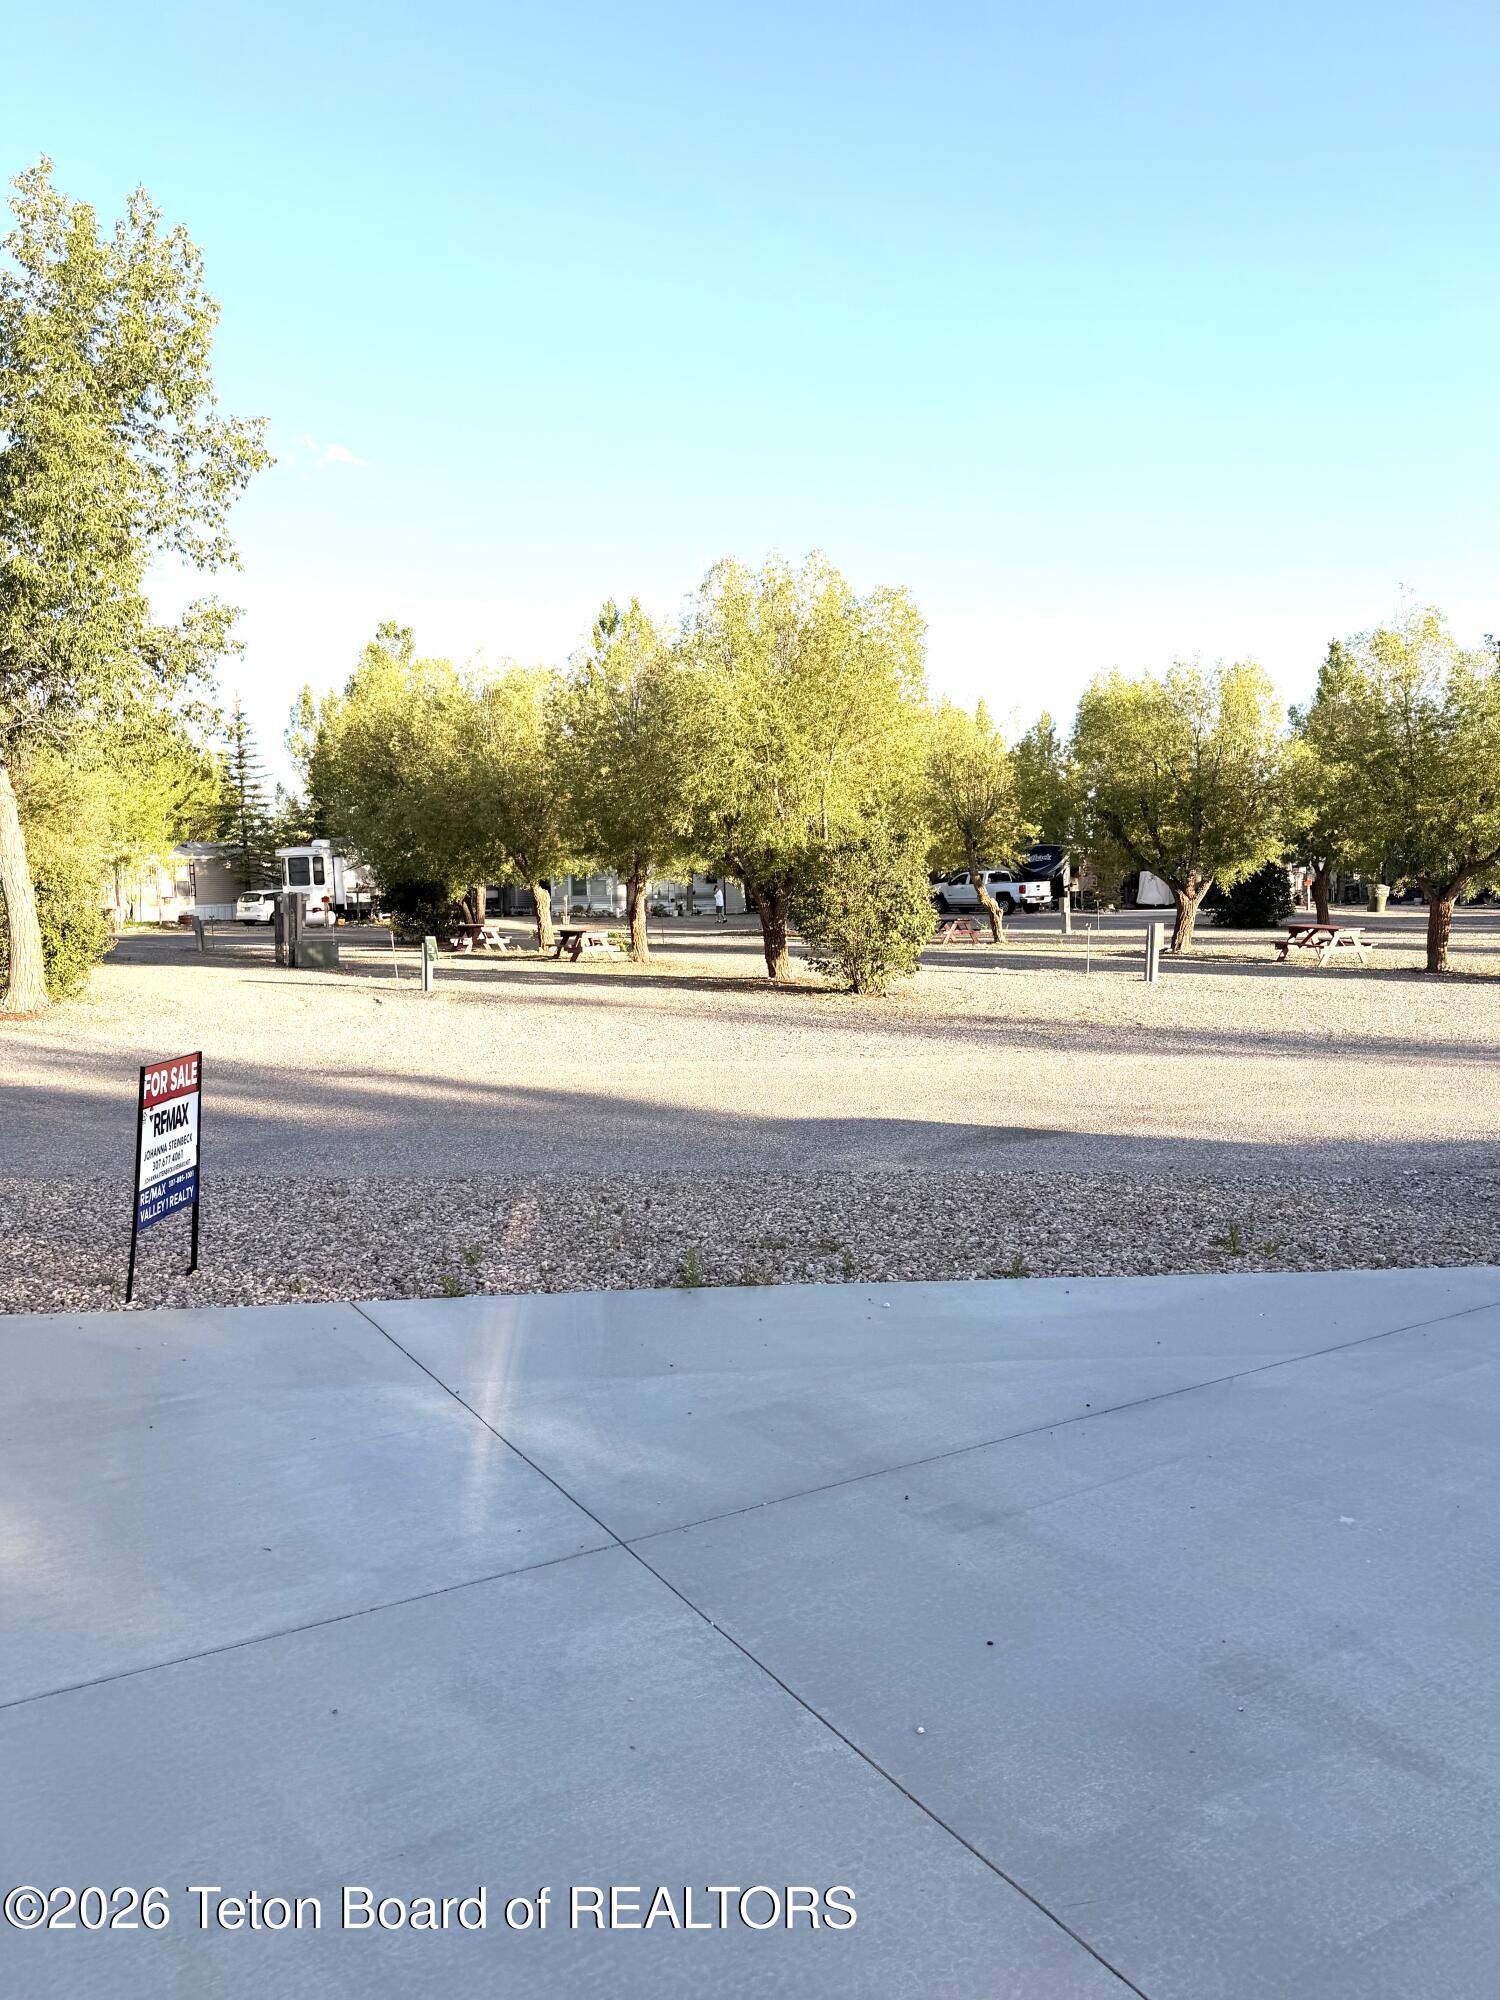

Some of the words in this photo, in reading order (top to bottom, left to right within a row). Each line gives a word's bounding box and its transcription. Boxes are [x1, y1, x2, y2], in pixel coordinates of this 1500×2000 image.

[143, 1070, 168, 1099] FOR
[170, 1061, 198, 1091] SALE
[143, 1142, 168, 1162] JOHANNA
[168, 1132, 193, 1151] STEINBECK
[139, 1182, 167, 1206] RE/MAX
[140, 1199, 166, 1223] VALLEY
[169, 1185, 194, 1208] REALTY
